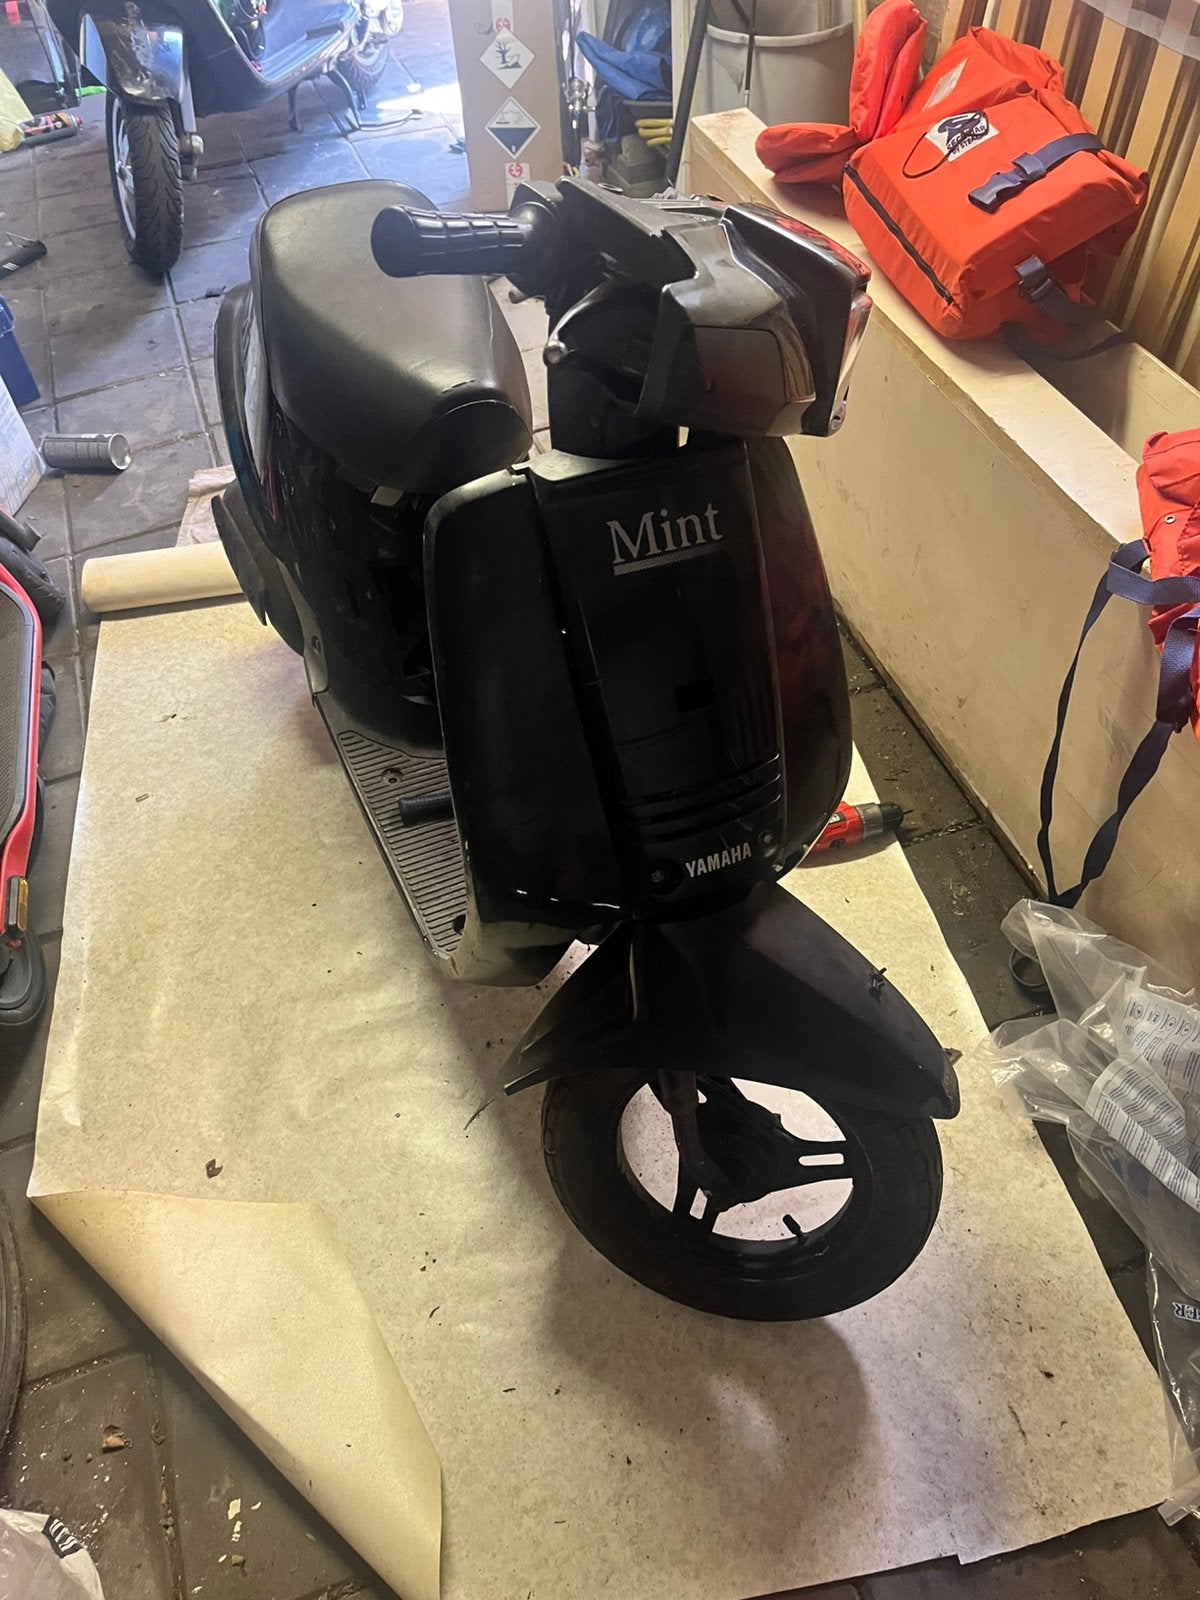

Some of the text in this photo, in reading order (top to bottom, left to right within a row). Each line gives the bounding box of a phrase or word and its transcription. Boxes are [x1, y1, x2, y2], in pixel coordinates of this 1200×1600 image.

[946, 124, 986, 150] SECAR
[606, 503, 723, 564] Mint
[685, 842, 752, 878] YAMAHA
